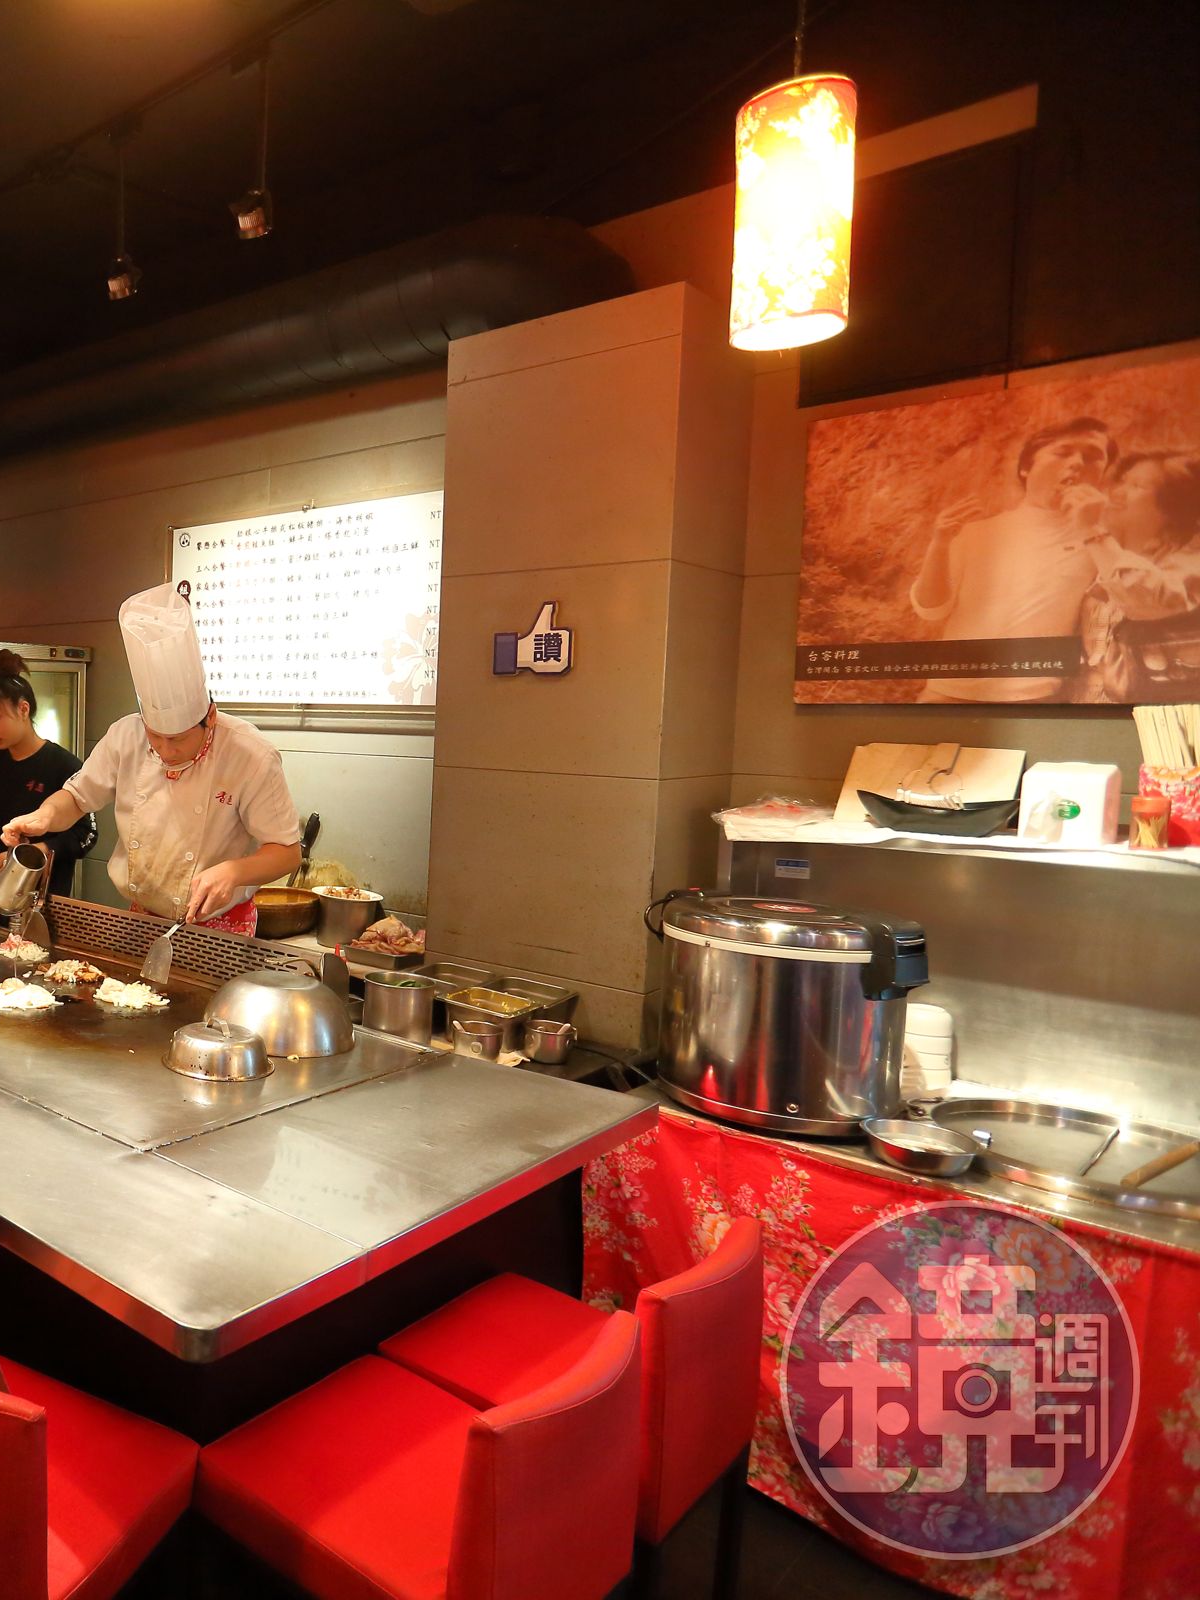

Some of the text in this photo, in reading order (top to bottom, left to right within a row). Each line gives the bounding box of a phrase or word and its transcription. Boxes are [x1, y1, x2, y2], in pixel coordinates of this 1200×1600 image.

[430, 511, 441, 520] NT
[429, 539, 440, 548] NT
[428, 561, 440, 570] NT
[427, 584, 439, 592] NT
[426, 605, 438, 614] NT
[426, 627, 437, 636] NT
[533, 632, 562, 663] 讚
[425, 649, 436, 658] NT
[808, 649, 860, 662] 台客料理
[424, 670, 435, 679] NT
